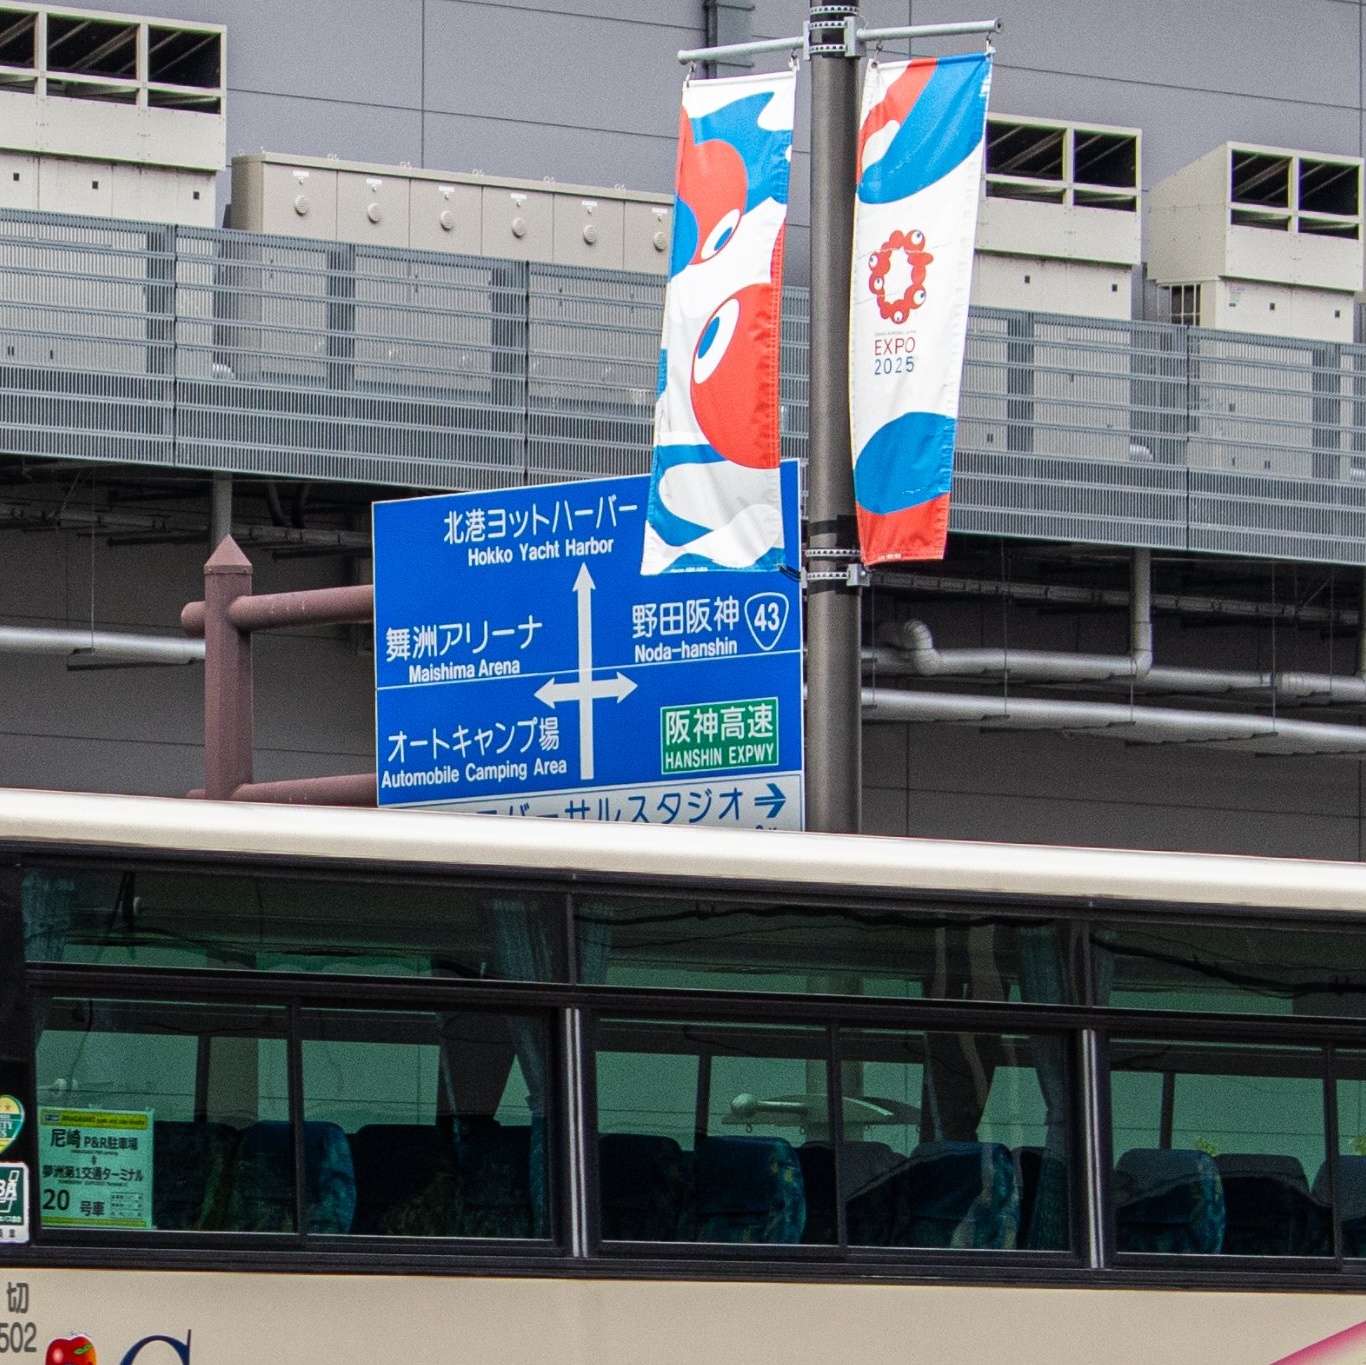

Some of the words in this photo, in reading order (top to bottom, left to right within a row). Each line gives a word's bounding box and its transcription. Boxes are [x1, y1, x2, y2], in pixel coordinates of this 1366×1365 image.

[874, 336, 916, 356] EXPO
[874, 356, 915, 375] 2025
[443, 494, 638, 545] 北港ヨットハーバー
[468, 546, 513, 567] Hokko
[519, 541, 560, 561] Yacht
[565, 536, 615, 557] Harbor
[632, 595, 740, 639] 野田阪神
[753, 602, 780, 632] 43
[386, 615, 543, 663] 舞洲アリーナ
[635, 636, 738, 663] Noda-hanshin
[408, 662, 475, 684] Maishima
[478, 658, 521, 678] Arena
[665, 702, 774, 746] 阪神高速
[387, 716, 560, 764] オートキャンプ場
[665, 748, 723, 770] HANSHIN
[728, 743, 774, 765] EXPWY
[381, 765, 460, 789] Automobile
[465, 760, 528, 783] Camping
[533, 757, 567, 776] Area
[42, 1188, 71, 1211] 20
[80, 1200, 106, 1217] 号車
